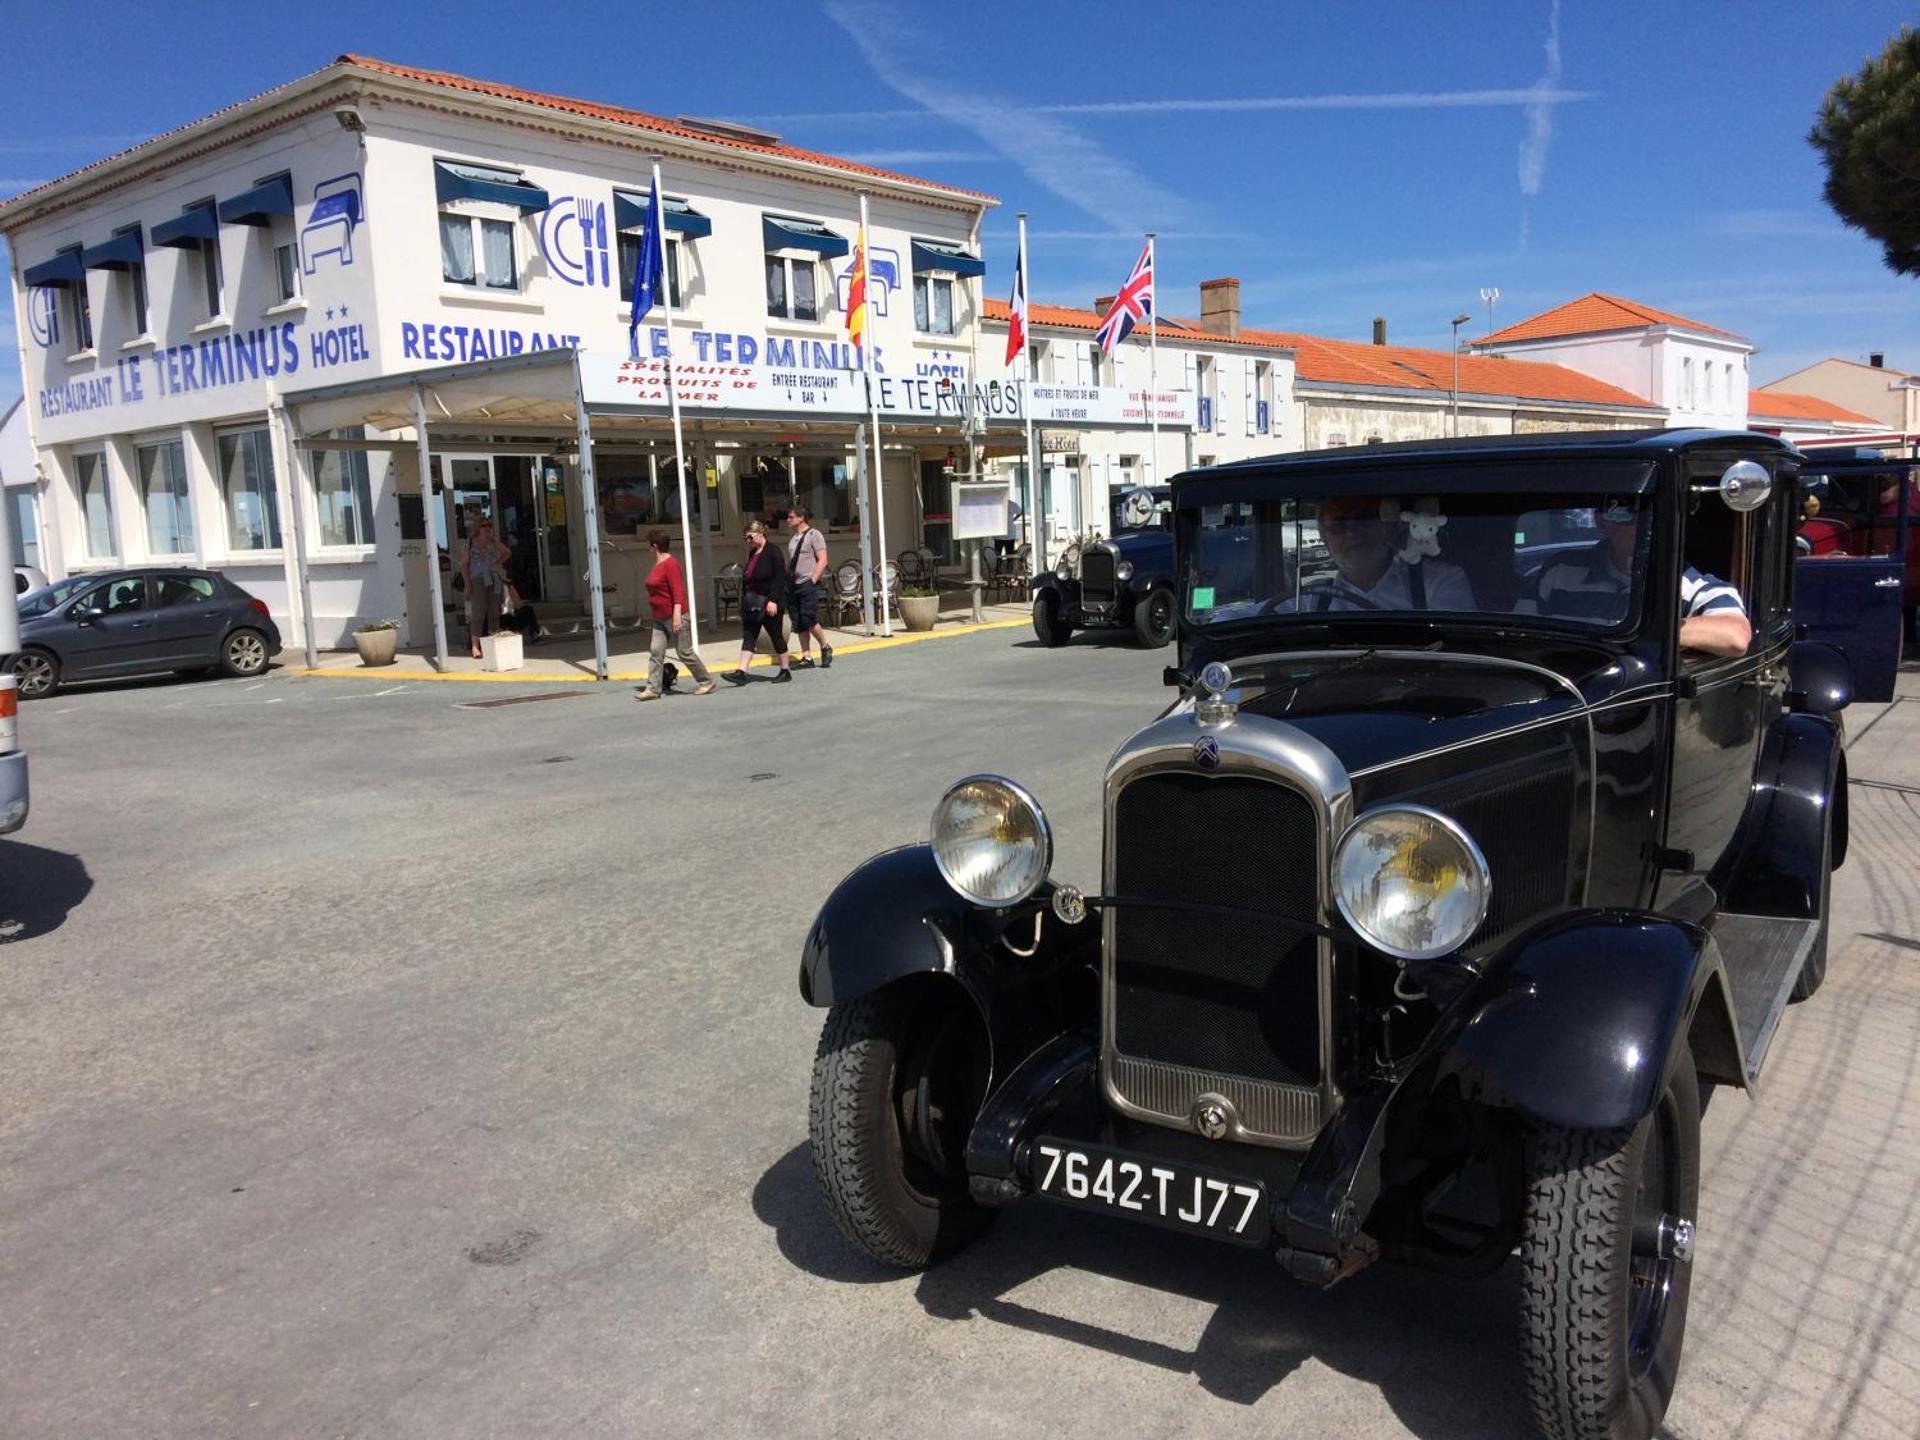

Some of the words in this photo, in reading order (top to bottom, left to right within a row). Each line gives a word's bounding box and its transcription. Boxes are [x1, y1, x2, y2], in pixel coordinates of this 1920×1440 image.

[40, 375, 113, 418] RESTAURANT
[117, 355, 144, 403] LE
[152, 321, 299, 396] TERMINUS
[310, 323, 370, 369] HOTEL
[732, 381, 758, 390] DE
[799, 374, 838, 389] RESTAURANT
[638, 390, 662, 399] LA
[802, 391, 815, 404] BAR
[901, 378, 1018, 414] TERMNUS
